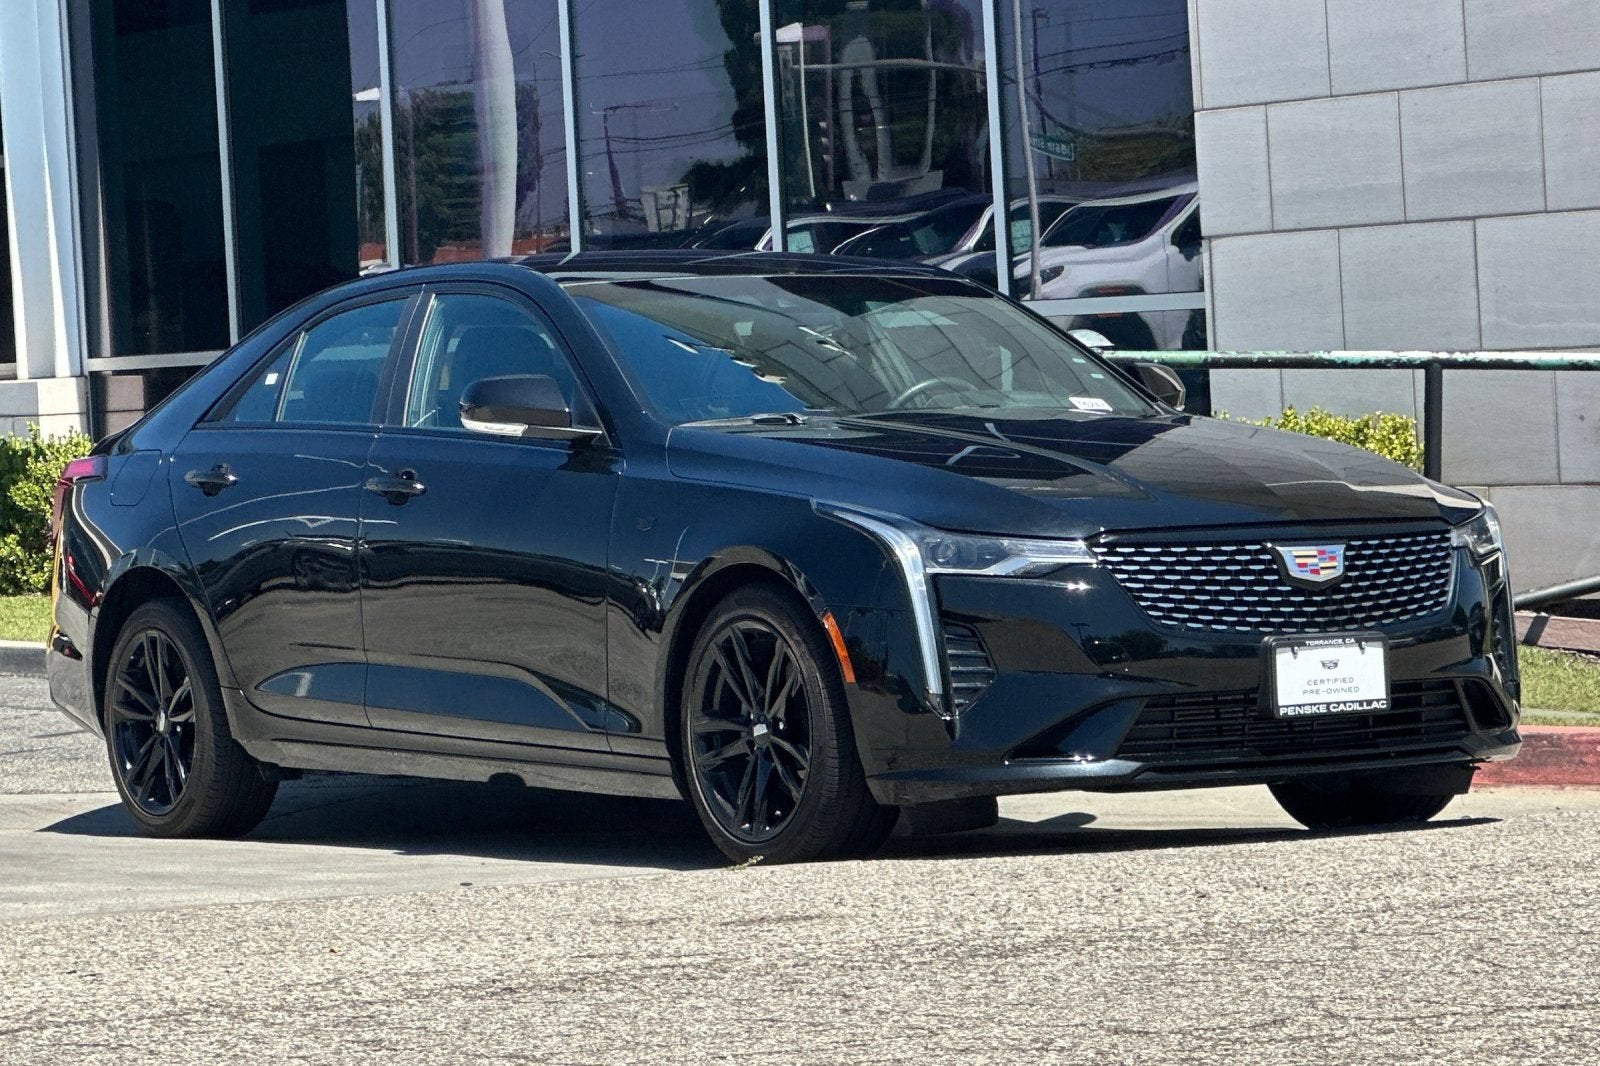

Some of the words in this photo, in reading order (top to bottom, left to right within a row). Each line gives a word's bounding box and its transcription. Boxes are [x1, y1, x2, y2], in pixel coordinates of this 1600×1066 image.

[1306, 677, 1355, 686] CERTIFIED
[1302, 686, 1360, 695] PRE-OWNED
[1279, 704, 1327, 716] PENSKE
[1329, 700, 1387, 712] CADILLAC
